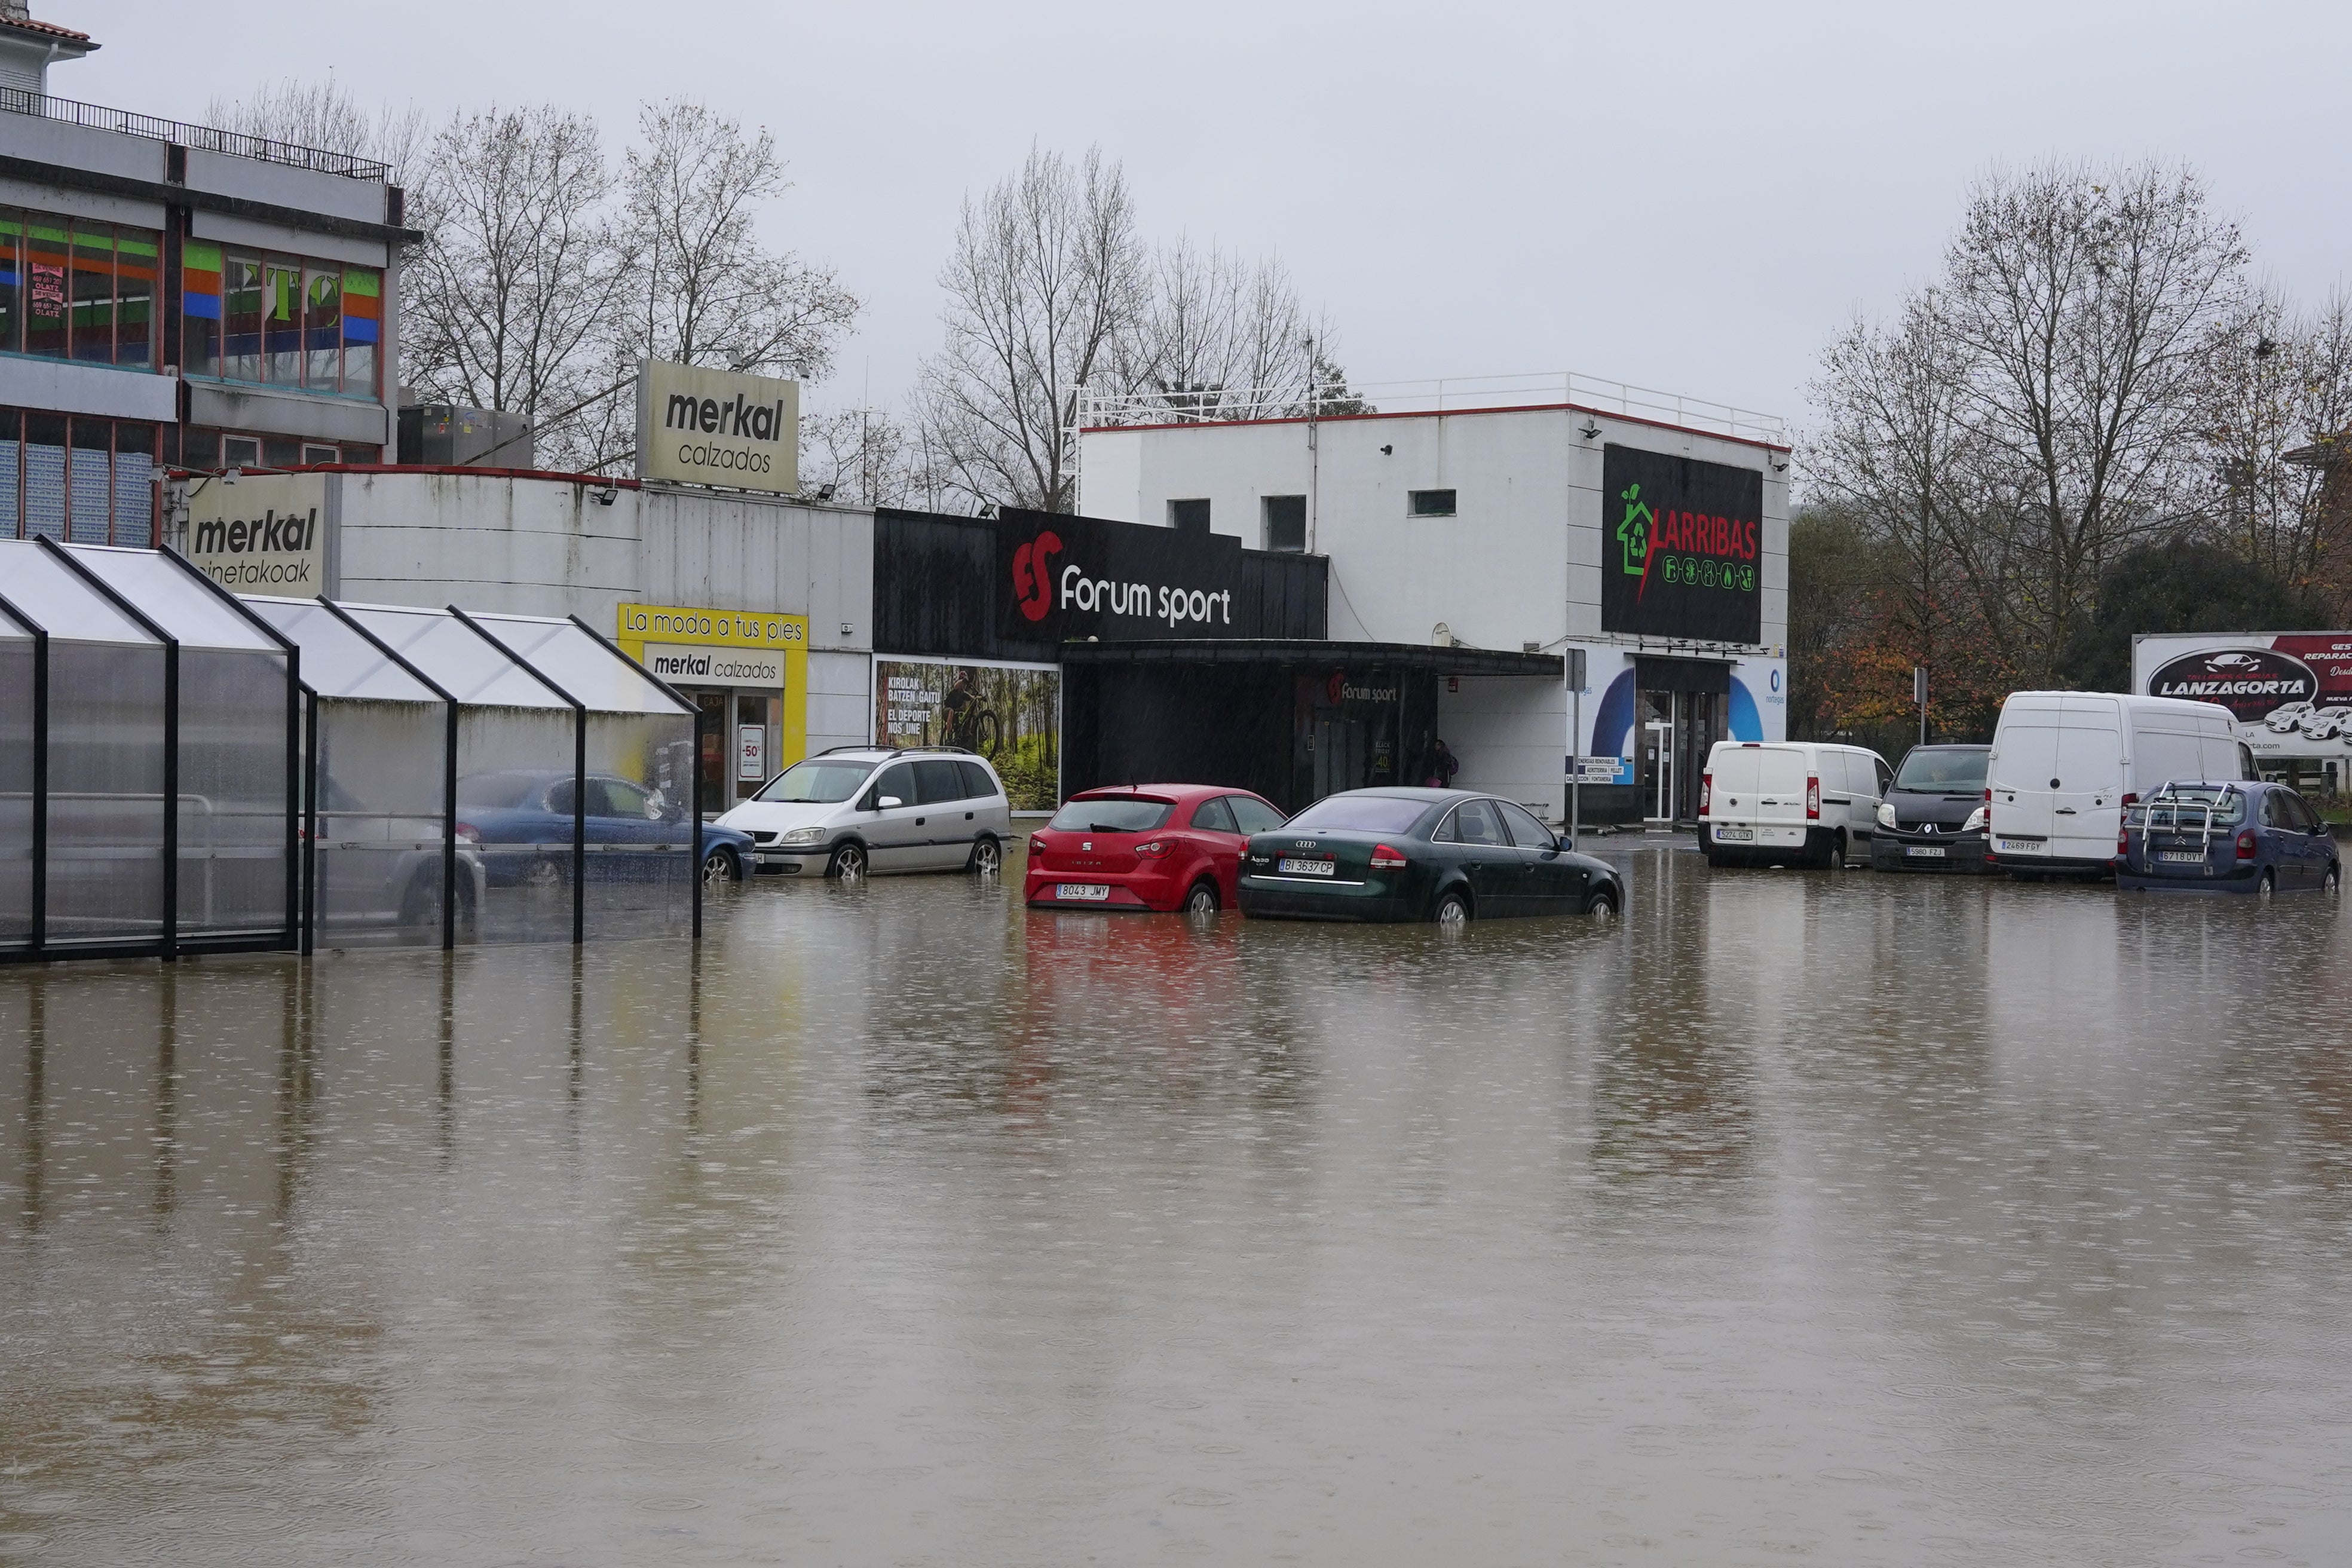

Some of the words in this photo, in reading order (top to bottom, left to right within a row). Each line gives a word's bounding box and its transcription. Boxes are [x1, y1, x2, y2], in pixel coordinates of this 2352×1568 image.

[35, 283, 59, 292] OLATZ
[35, 308, 60, 317] OLATZ
[666, 393, 783, 442] merkal
[679, 441, 770, 473] calzados
[195, 508, 317, 553] merkal
[1061, 564, 1152, 617] forum
[1157, 586, 1230, 628] sport
[627, 607, 648, 632] La
[654, 611, 712, 636] moda
[716, 618, 730, 636] a
[735, 614, 760, 638] tus
[766, 617, 803, 644] pies
[654, 654, 712, 676] merkal
[713, 660, 777, 679] calzados
[888, 676, 919, 690] KIROLAK
[2160, 680, 2305, 695] LANZAGORTA
[1342, 682, 1371, 700] forum
[1371, 687, 1396, 703] sport
[887, 709, 897, 721] EL
[898, 709, 931, 722] DEPORTE
[2163, 852, 2185, 860] 6718
[1285, 860, 1295, 871] BI
[1296, 860, 1319, 872] 3637
[1321, 862, 1333, 873] CP
[1062, 885, 1086, 896] 8043
[1090, 886, 1107, 896] JMY
